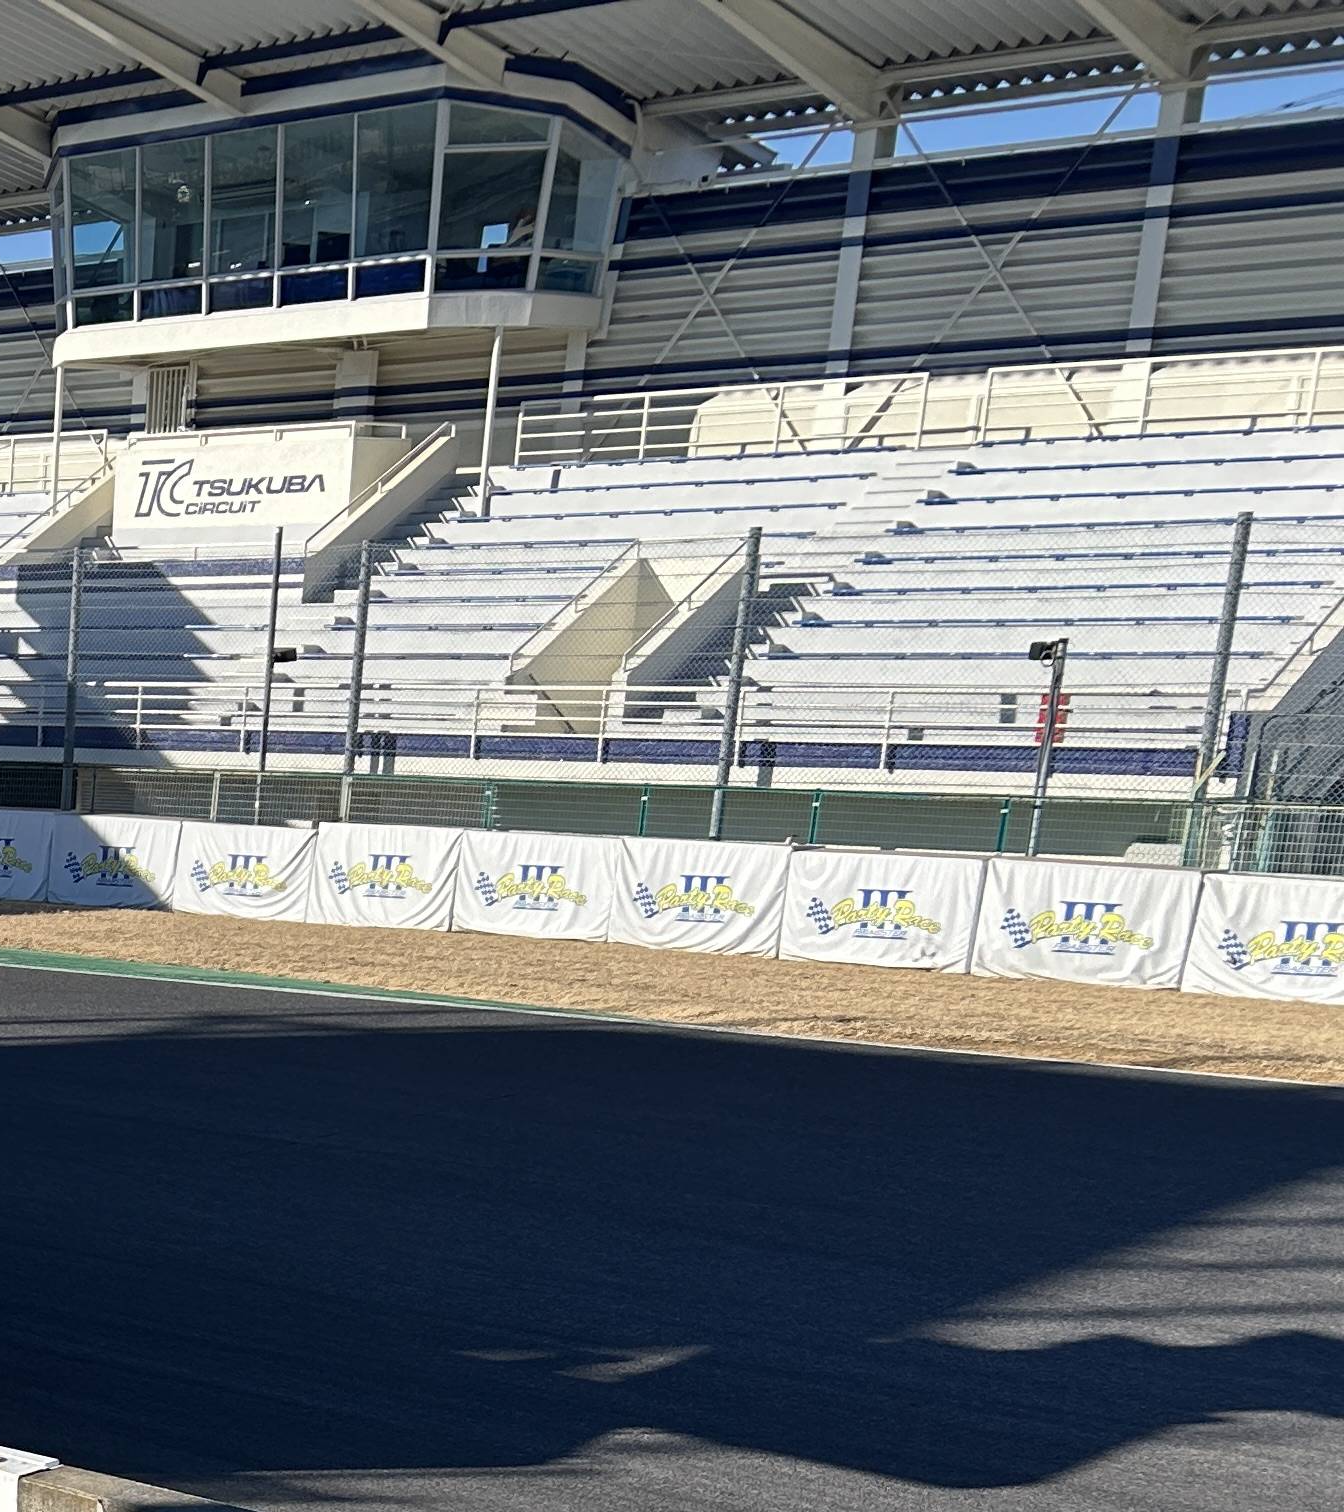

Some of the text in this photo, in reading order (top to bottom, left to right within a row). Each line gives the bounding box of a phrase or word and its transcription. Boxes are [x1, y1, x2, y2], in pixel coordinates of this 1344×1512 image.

[193, 474, 326, 497] TSUKUBA
[347, 862, 394, 888] Party
[496, 872, 587, 906] Party Race
[654, 884, 755, 917] Party Race
[831, 898, 942, 934] Party Race
[1028, 909, 1154, 949] Party Race
[1248, 931, 1319, 965] Party
